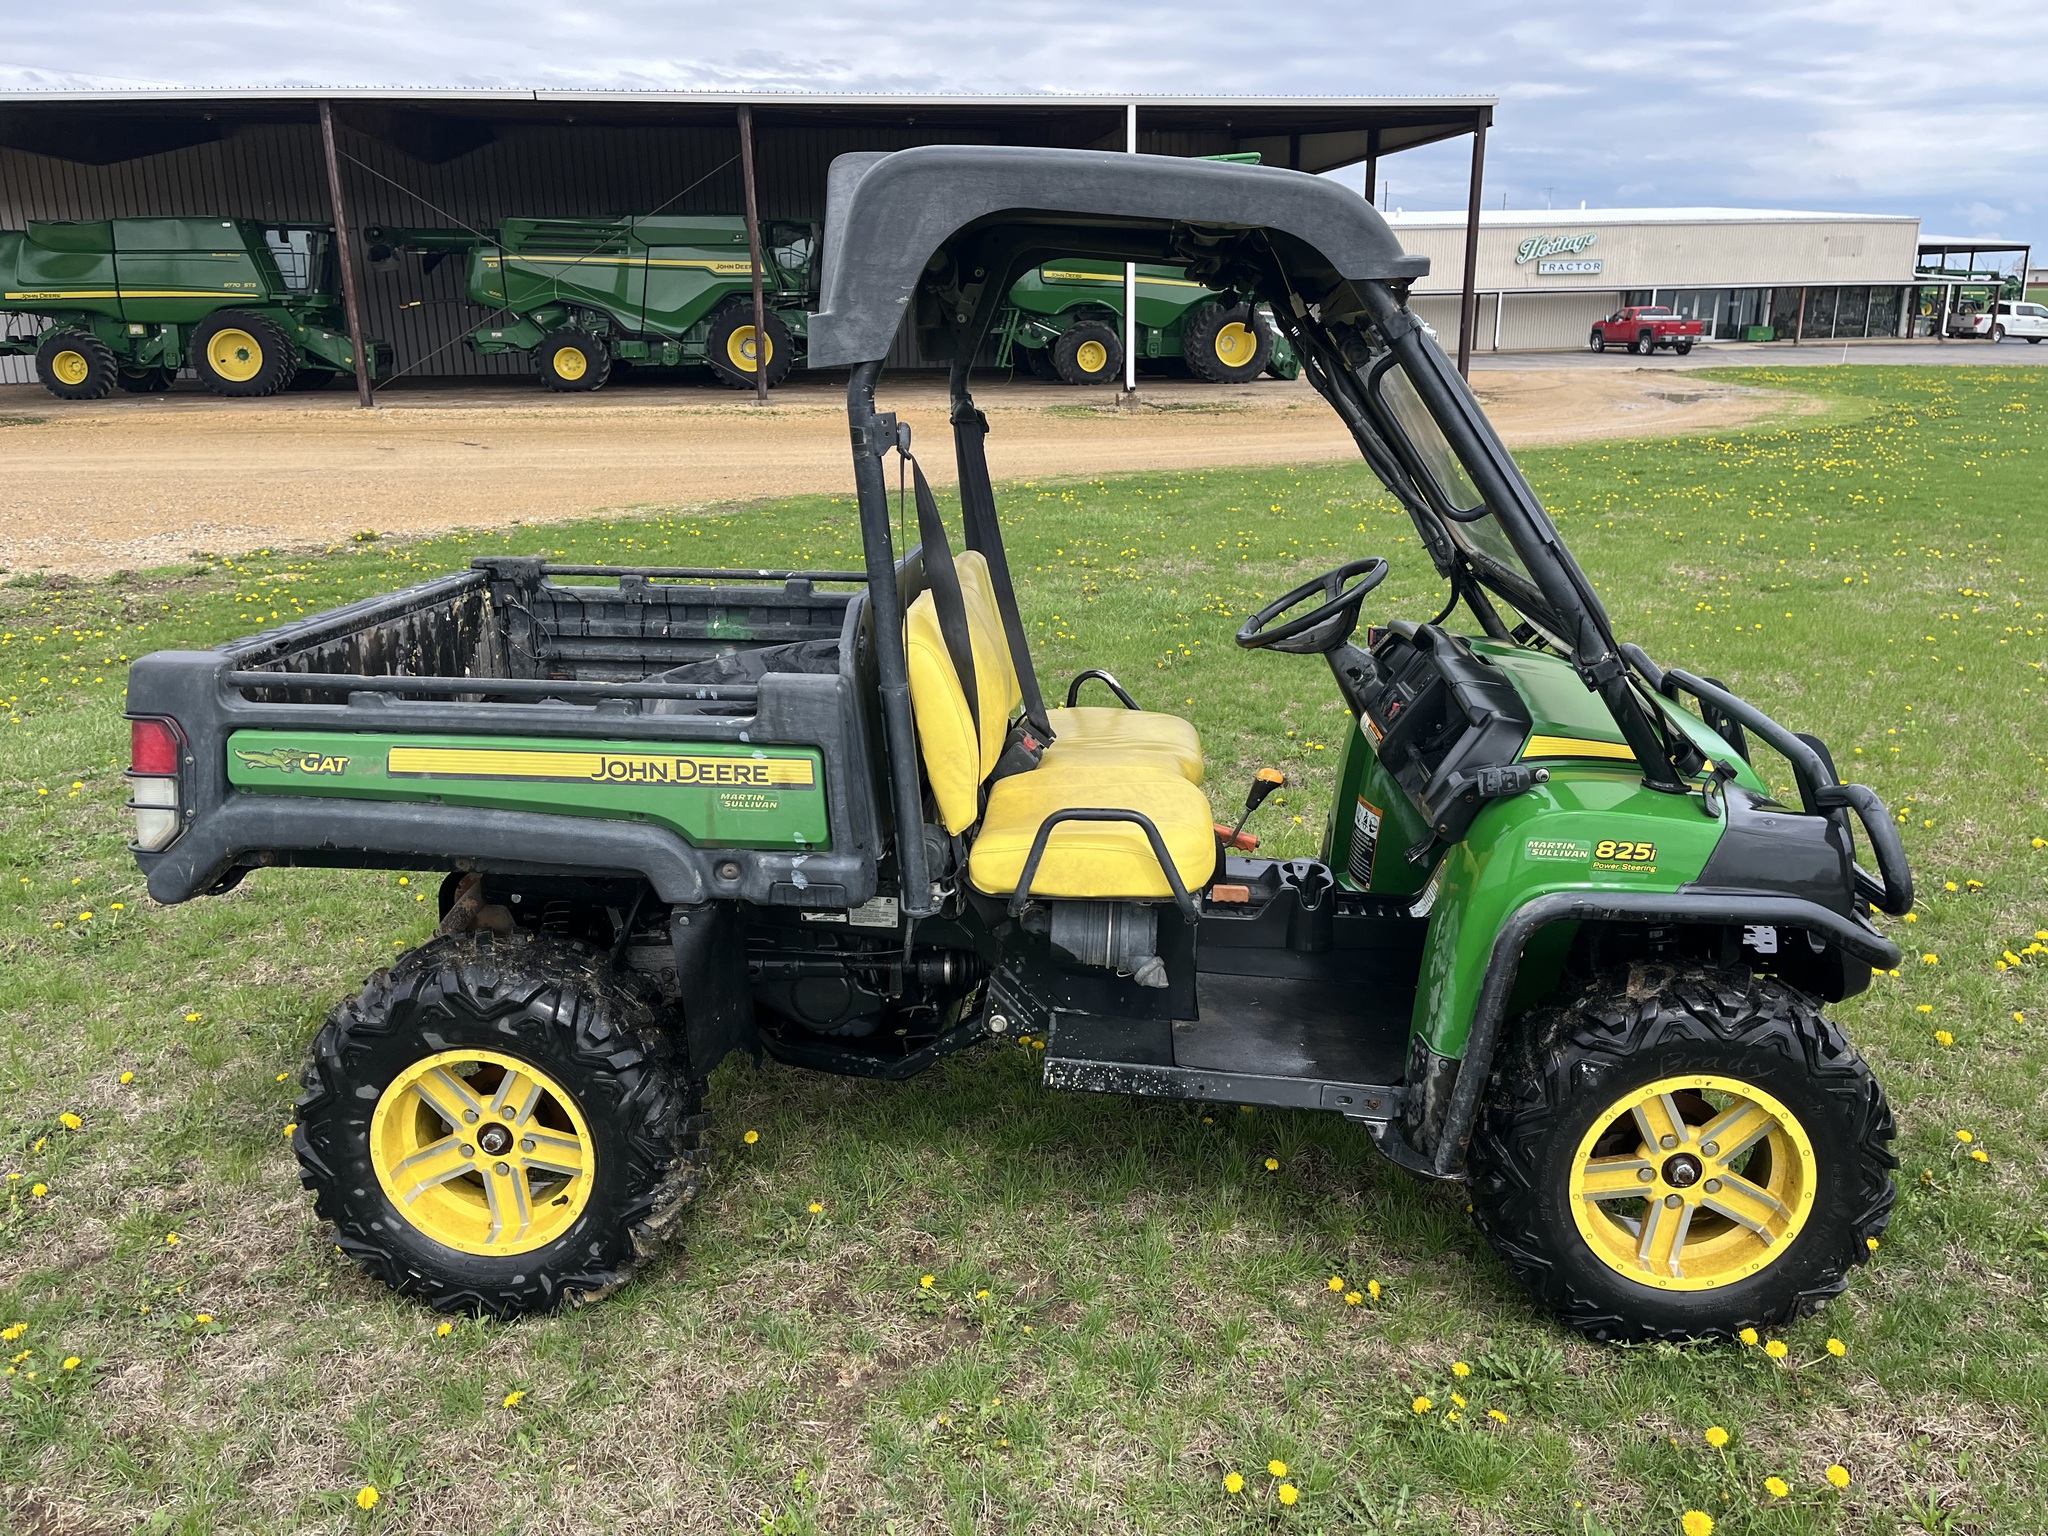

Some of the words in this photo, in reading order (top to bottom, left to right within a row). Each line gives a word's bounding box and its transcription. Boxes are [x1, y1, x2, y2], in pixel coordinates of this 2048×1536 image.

[1516, 232, 1597, 264] Heritage
[1541, 262, 1601, 272] TRACTOR
[592, 757, 668, 780] JOHN
[675, 759, 769, 783] DEERE
[720, 793, 765, 801] MARTIN
[724, 800, 778, 809] SULLIVAN
[1527, 840, 1576, 850] MARTIN
[1531, 848, 1589, 858] SULLIVAN
[1595, 840, 1657, 862] 825i
[1592, 861, 1619, 871] Power
[1621, 863, 1657, 873] Steering
[1660, 1050, 1777, 1079] Brady
